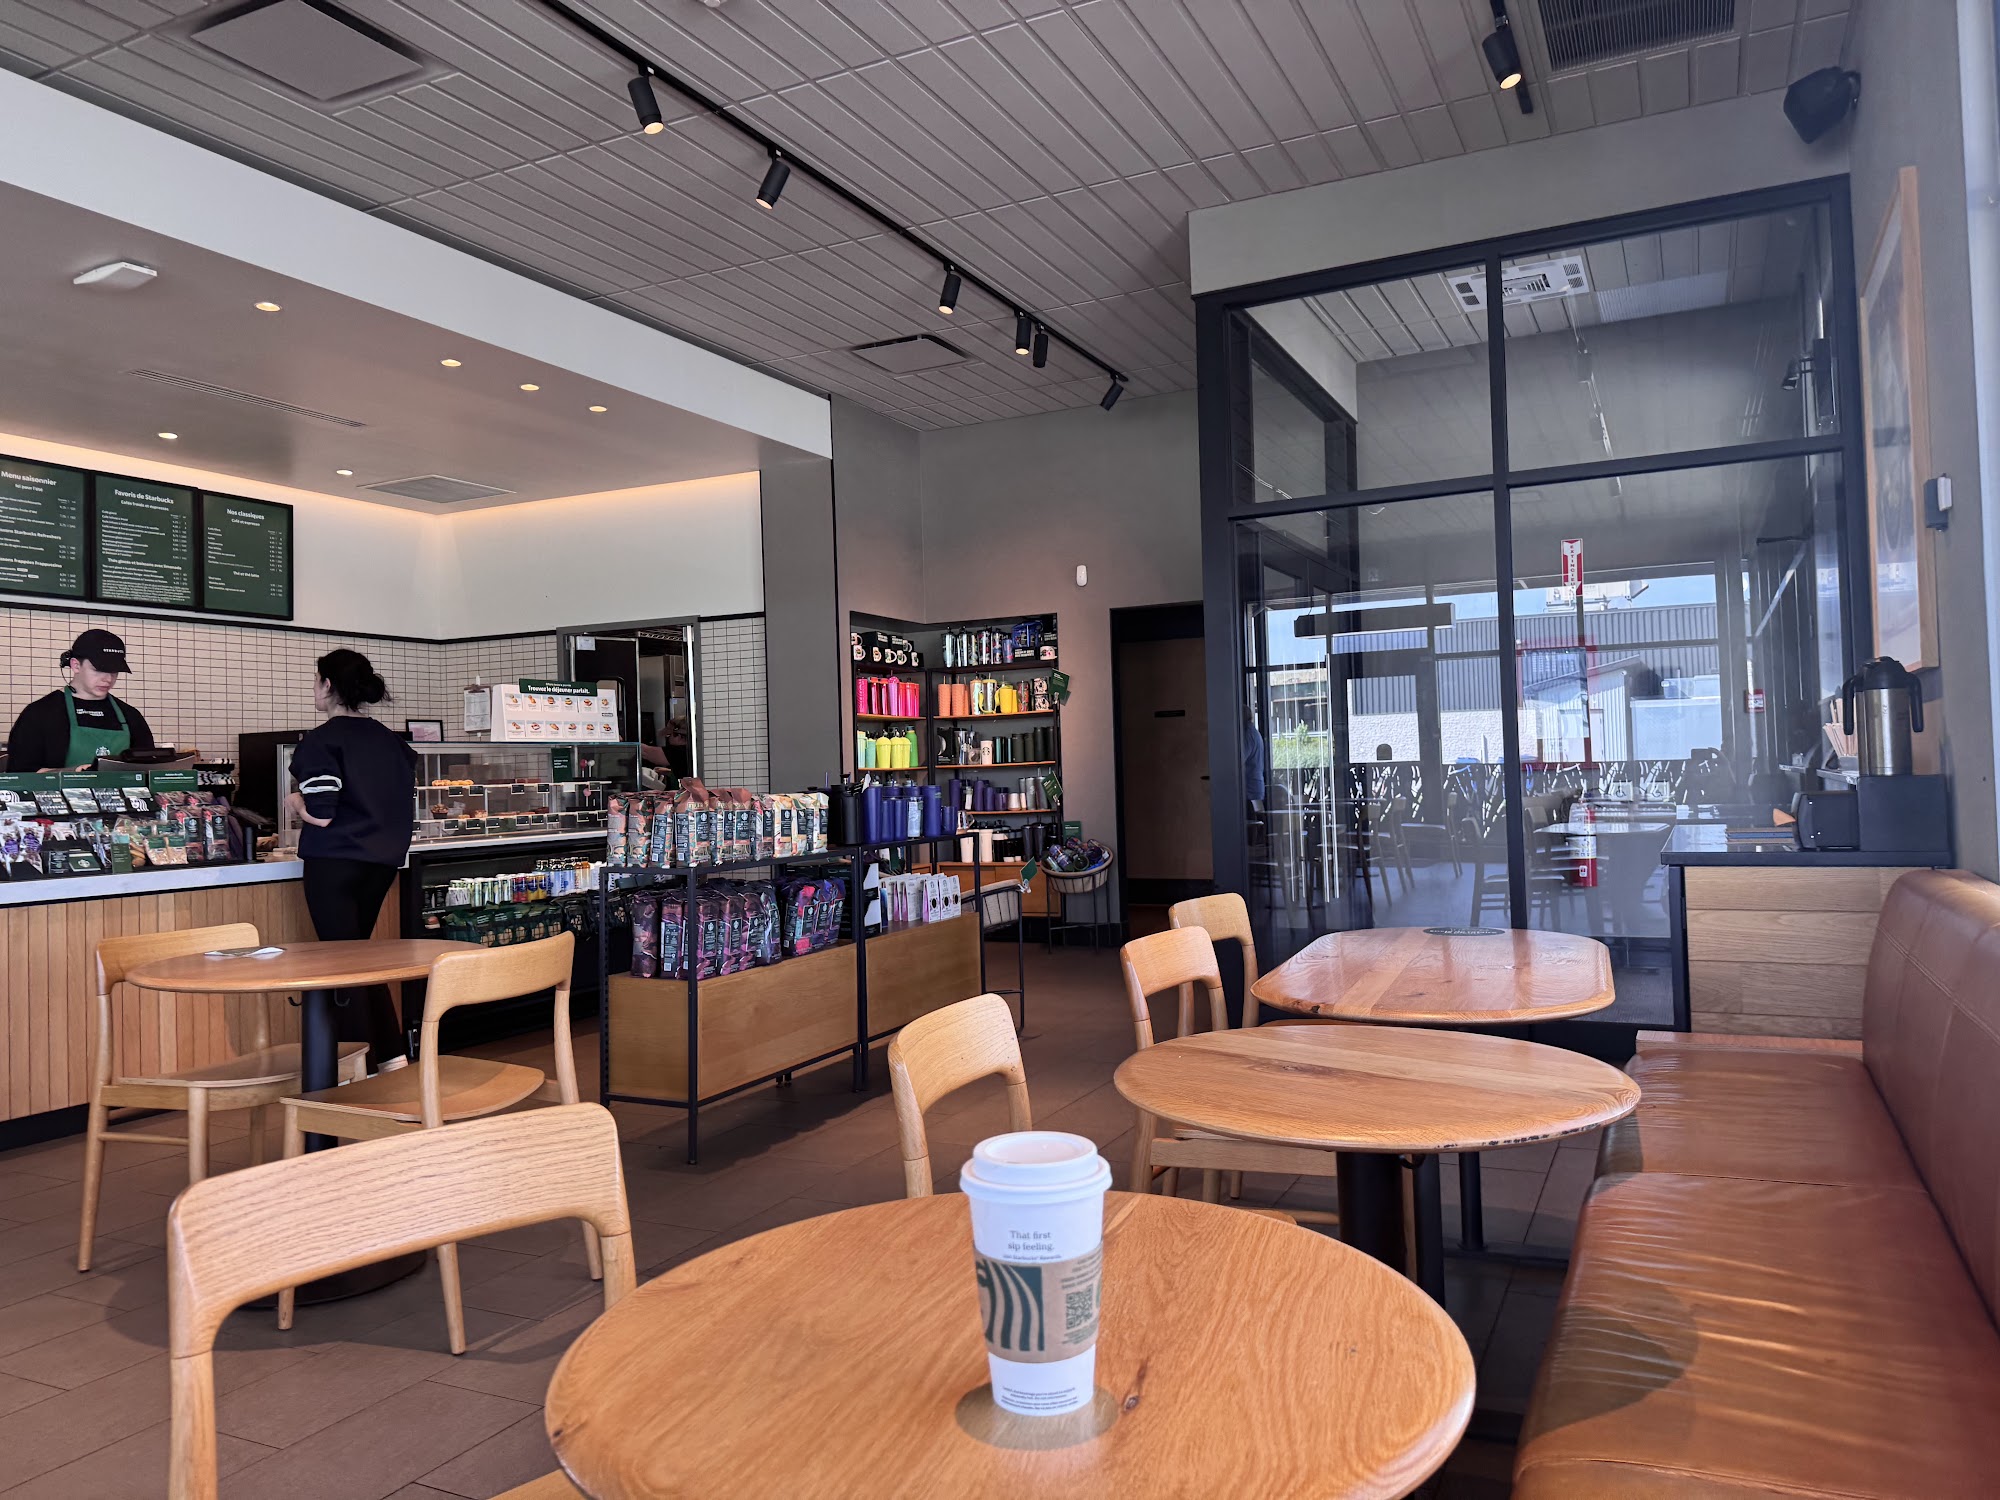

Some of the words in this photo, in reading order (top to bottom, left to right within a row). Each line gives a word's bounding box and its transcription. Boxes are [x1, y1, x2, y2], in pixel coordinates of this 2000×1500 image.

[1, 470, 22, 480] Menu
[22, 474, 57, 486] saisonnier
[114, 489, 136, 498] Favoris
[145, 494, 174, 504] Starbucks
[238, 510, 265, 520] classiques
[551, 686, 572, 694] déjeuner
[1009, 1230, 1030, 1239] That
[1033, 1230, 1051, 1239] first
[1008, 1242, 1020, 1251] sip
[1022, 1242, 1055, 1251] feeling.
